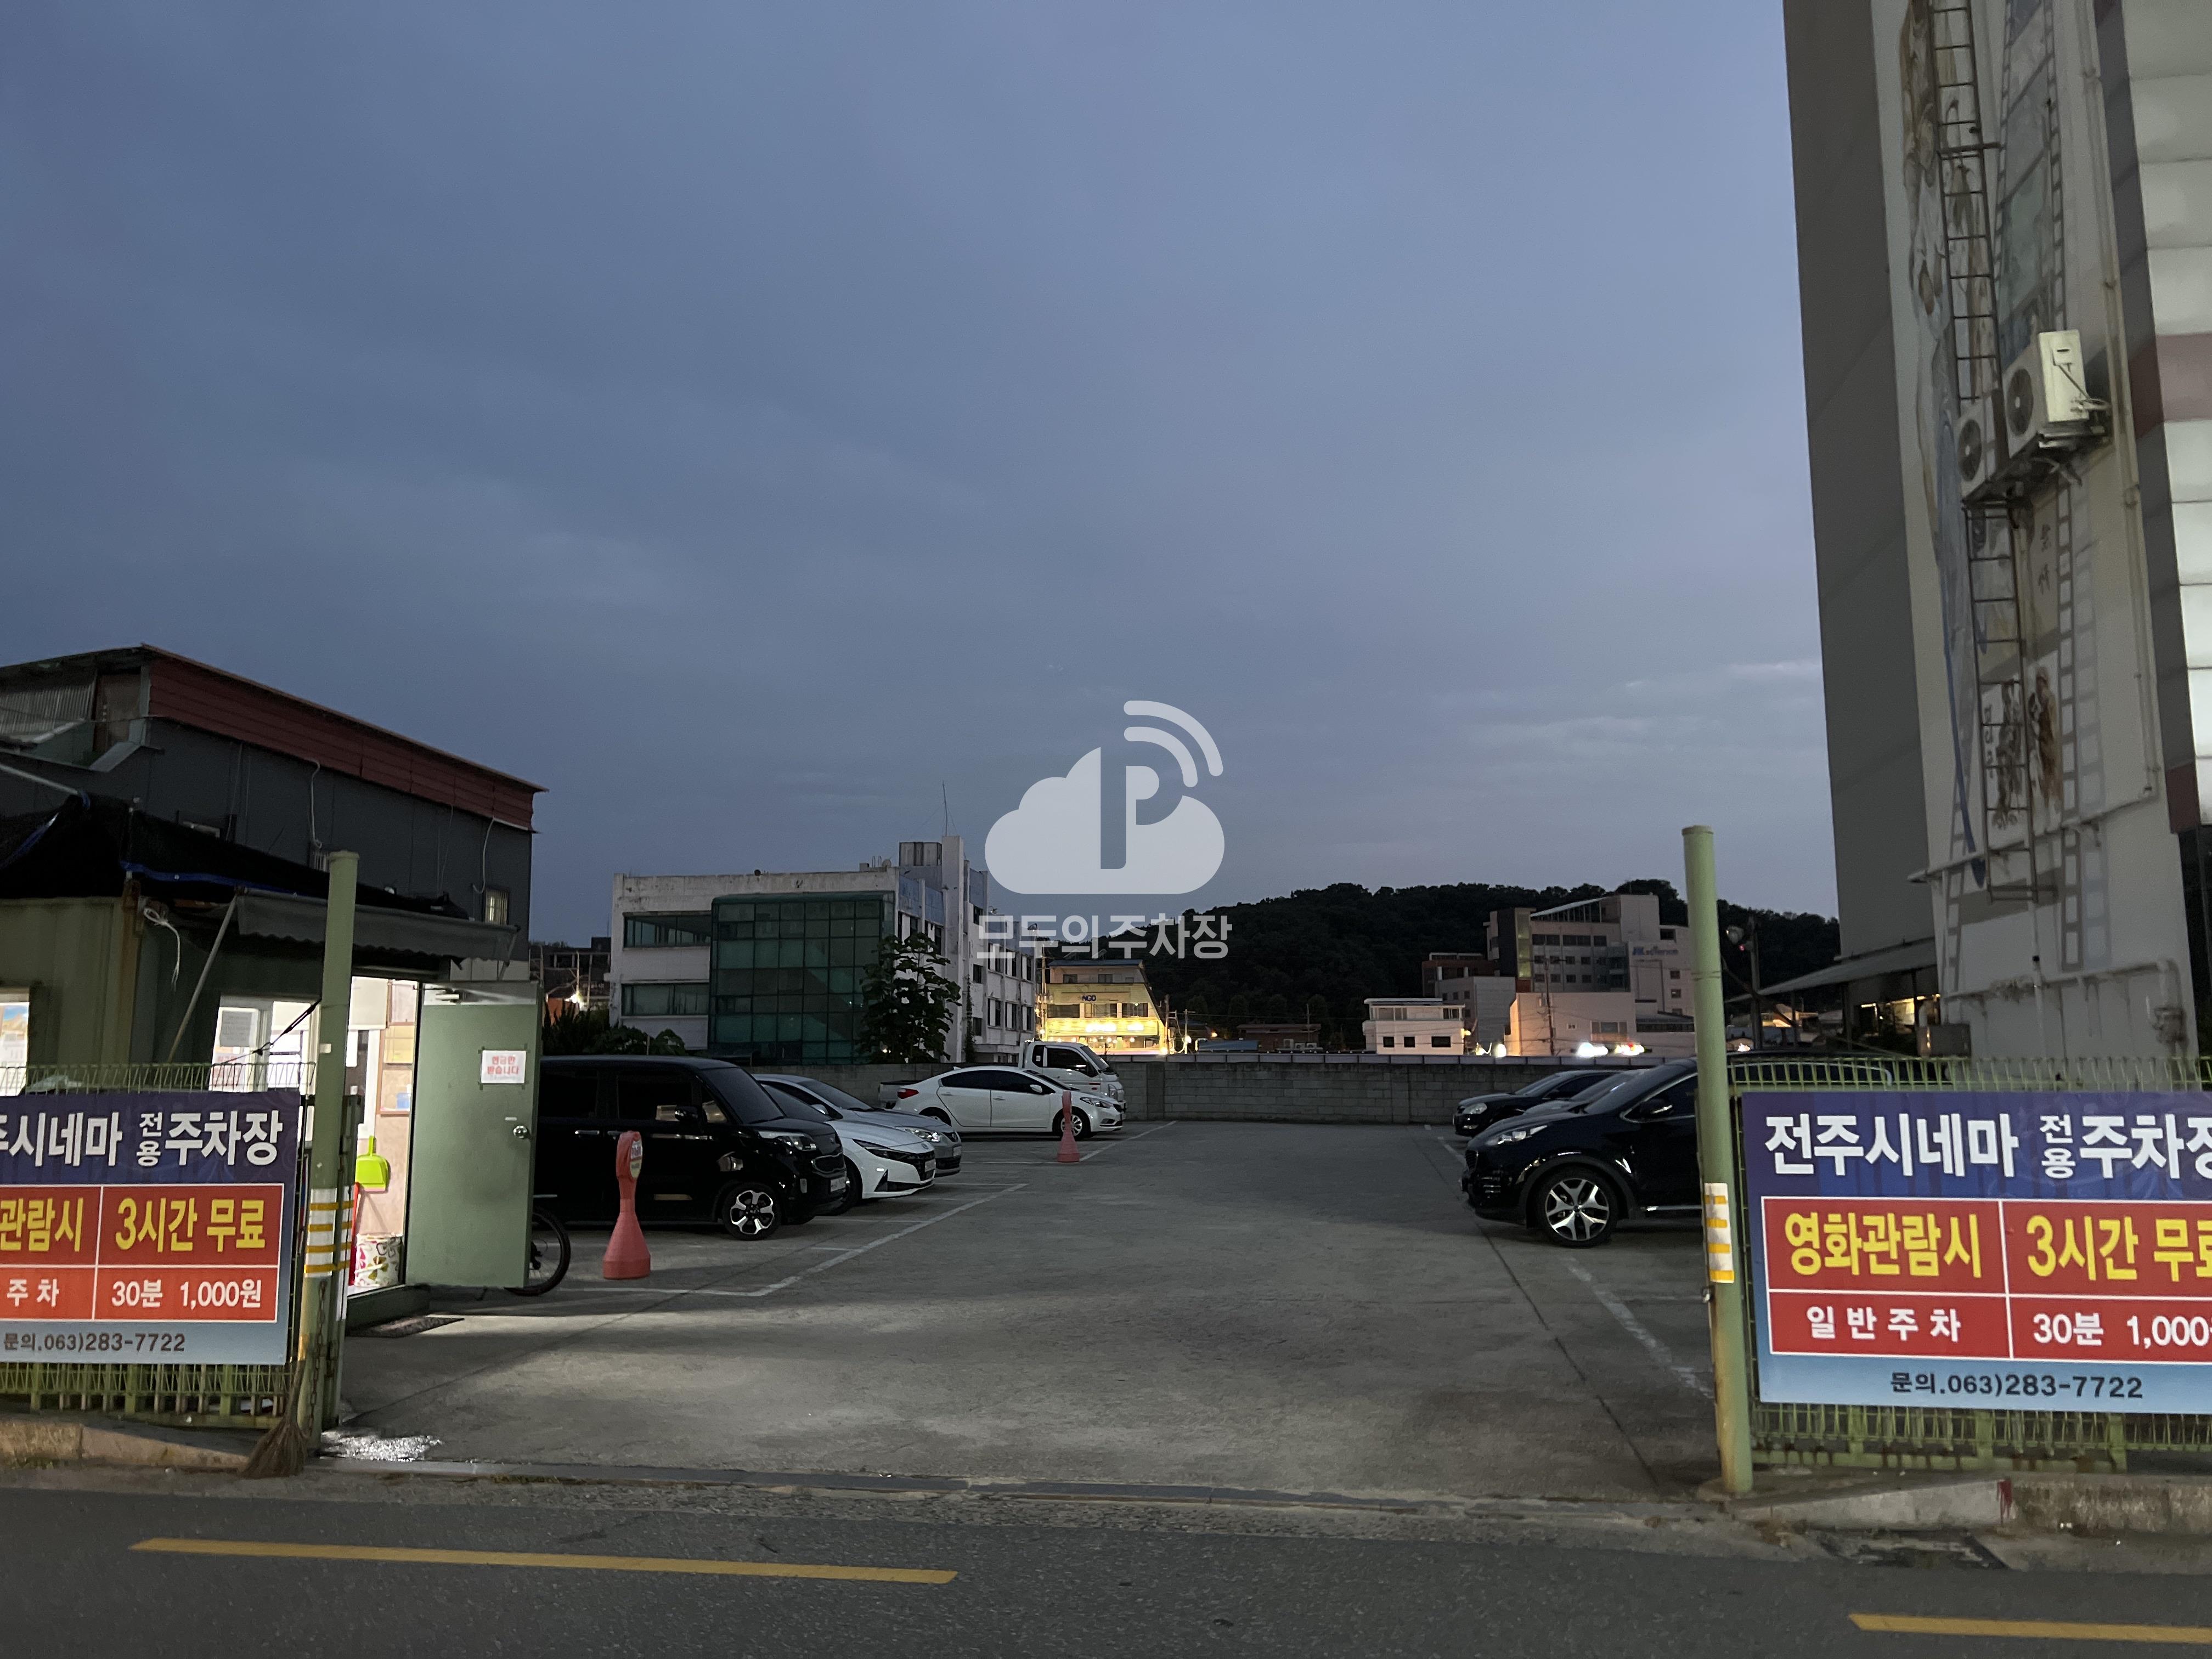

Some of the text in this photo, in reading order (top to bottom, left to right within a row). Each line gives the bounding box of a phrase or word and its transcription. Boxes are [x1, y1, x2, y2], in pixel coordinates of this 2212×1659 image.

[487, 1066, 519, 1075] 받습니다
[0, 1112, 122, 1166] 시네마
[165, 1110, 283, 1166] 주차장
[1765, 1113, 2019, 1177] 전주시네마
[0, 1198, 83, 1252] 관람시
[116, 1198, 265, 1252] 3시간 무료
[1785, 1212, 1981, 1278] 영화관람시
[2027, 1215, 2138, 1281] 3시간
[111, 1279, 262, 1310] 30분 1,000원
[2033, 1312, 2212, 1350] 30분 1,000
